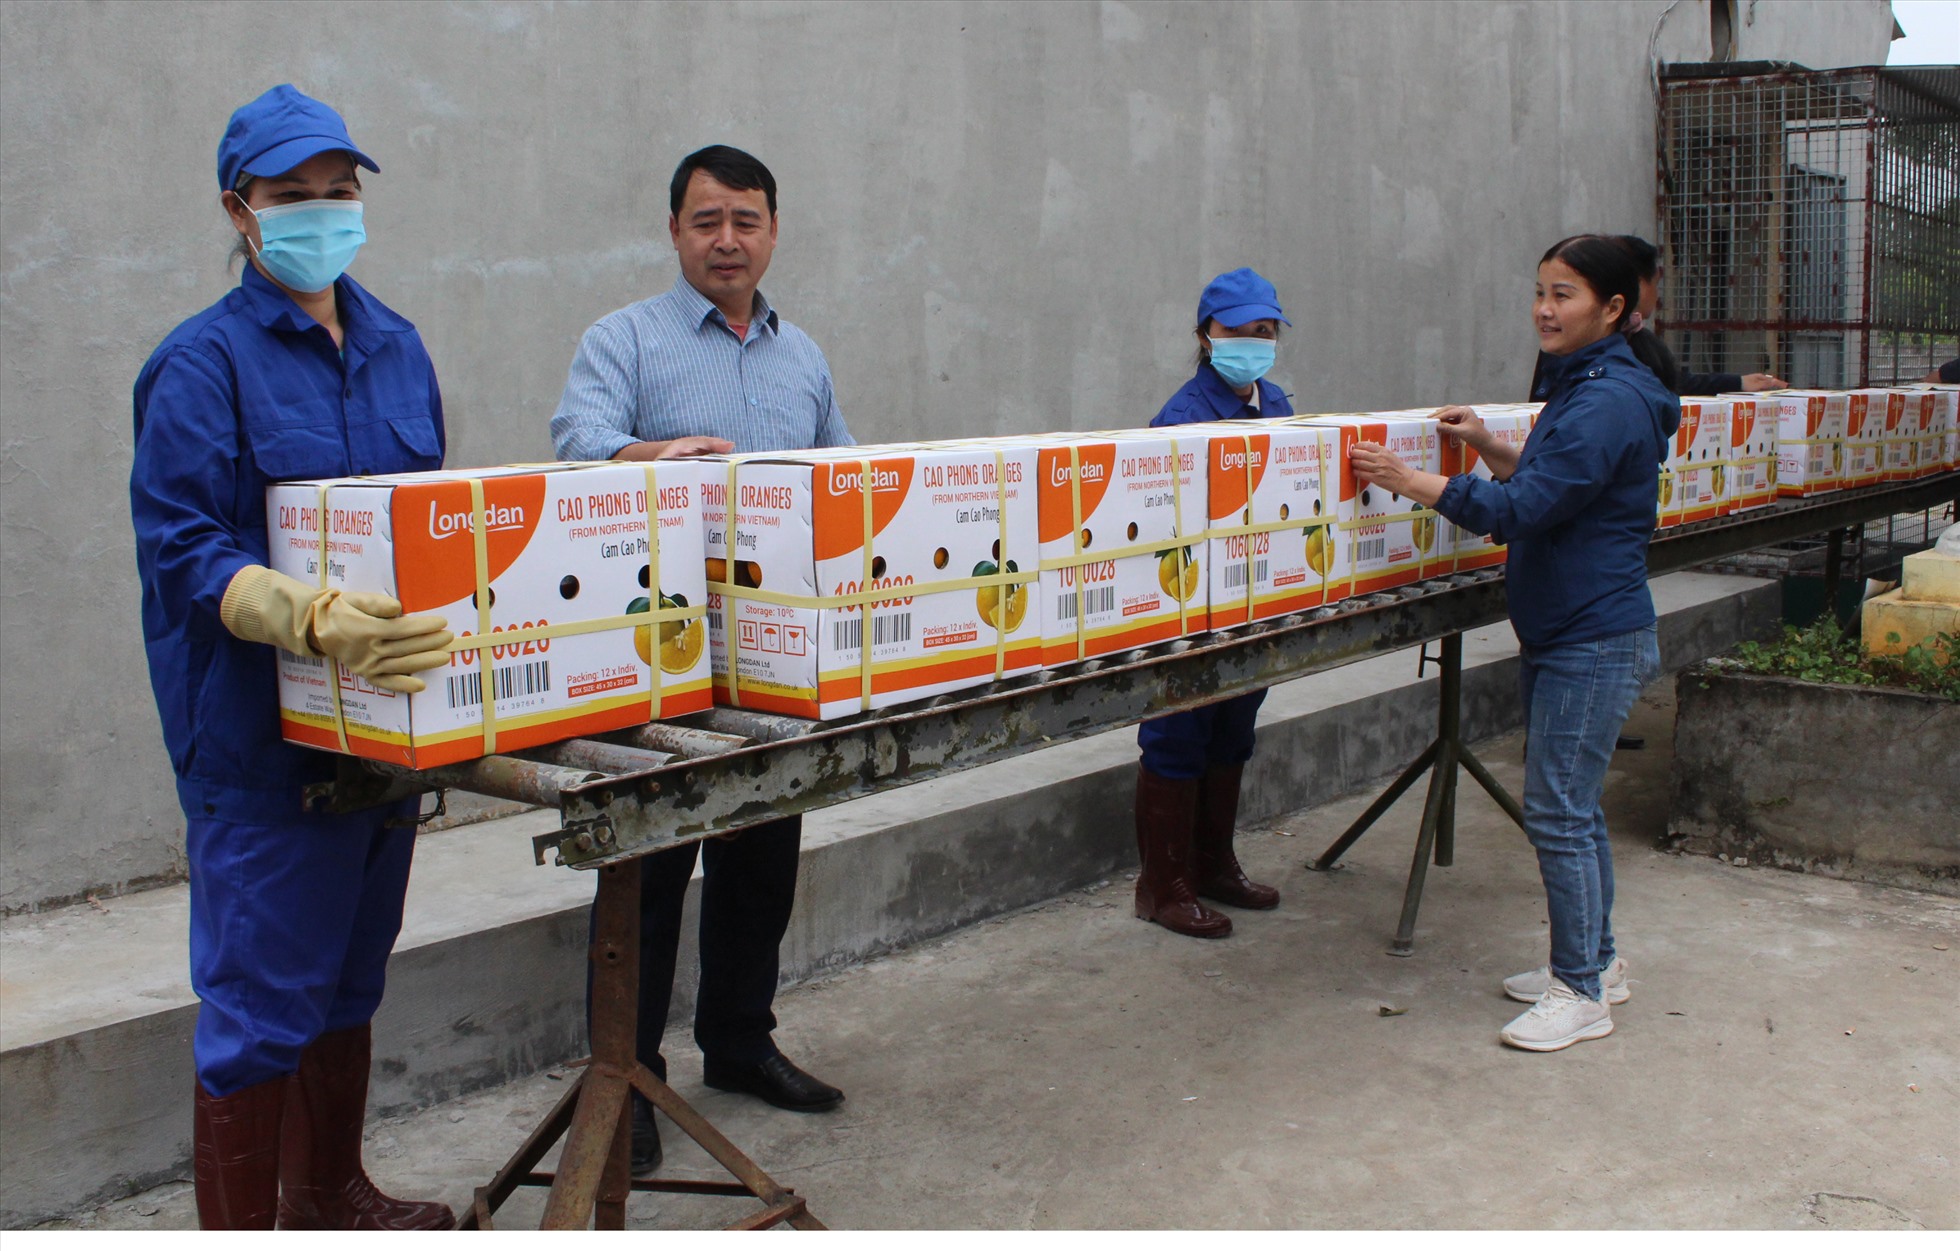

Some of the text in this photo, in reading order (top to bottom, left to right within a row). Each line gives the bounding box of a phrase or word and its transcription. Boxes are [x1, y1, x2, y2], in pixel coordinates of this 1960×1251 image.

[1274, 448, 1286, 464] CAO
[1288, 446, 1306, 462] PHONG
[924, 466, 943, 488] CAO
[948, 464, 978, 488] PHONG
[1052, 456, 1104, 488] Londan
[1121, 458, 1136, 478] CAO
[1138, 456, 1162, 476] PHONG
[1128, 483, 1143, 493] (FROM
[1144, 481, 1168, 491] NORTHERN
[557, 497, 583, 522] CAO
[588, 491, 631, 518] PHONG
[701, 484, 792, 510] PHON ORANGES
[932, 494, 954, 505] (FROM
[954, 492, 989, 504] NORTHERN
[1144, 495, 1154, 508] Cam
[1155, 494, 1163, 506] Cao
[280, 506, 373, 536] CAO PHOG ORANGES
[748, 515, 780, 528] VIETNAM)
[956, 506, 1000, 524] Cam Cao Phong
[568, 526, 598, 541] (FROM
[599, 521, 646, 536] NORTHERN
[708, 528, 722, 544] Cam
[736, 530, 757, 551] Phong
[288, 537, 306, 550] (FROM
[338, 542, 363, 557] VIETNAM)
[601, 542, 618, 558] Cam
[620, 540, 634, 556] Cao
[329, 560, 346, 582] Phong
[745, 605, 776, 618] Storage:
[923, 625, 948, 636] Packing:
[950, 623, 958, 632] 12
[962, 620, 978, 630] Indiv.
[306, 676, 326, 687] Vietnam
[567, 672, 599, 684] Packing:
[601, 668, 610, 678] 12
[618, 663, 638, 674] Indiv.
[753, 668, 764, 677] E10
